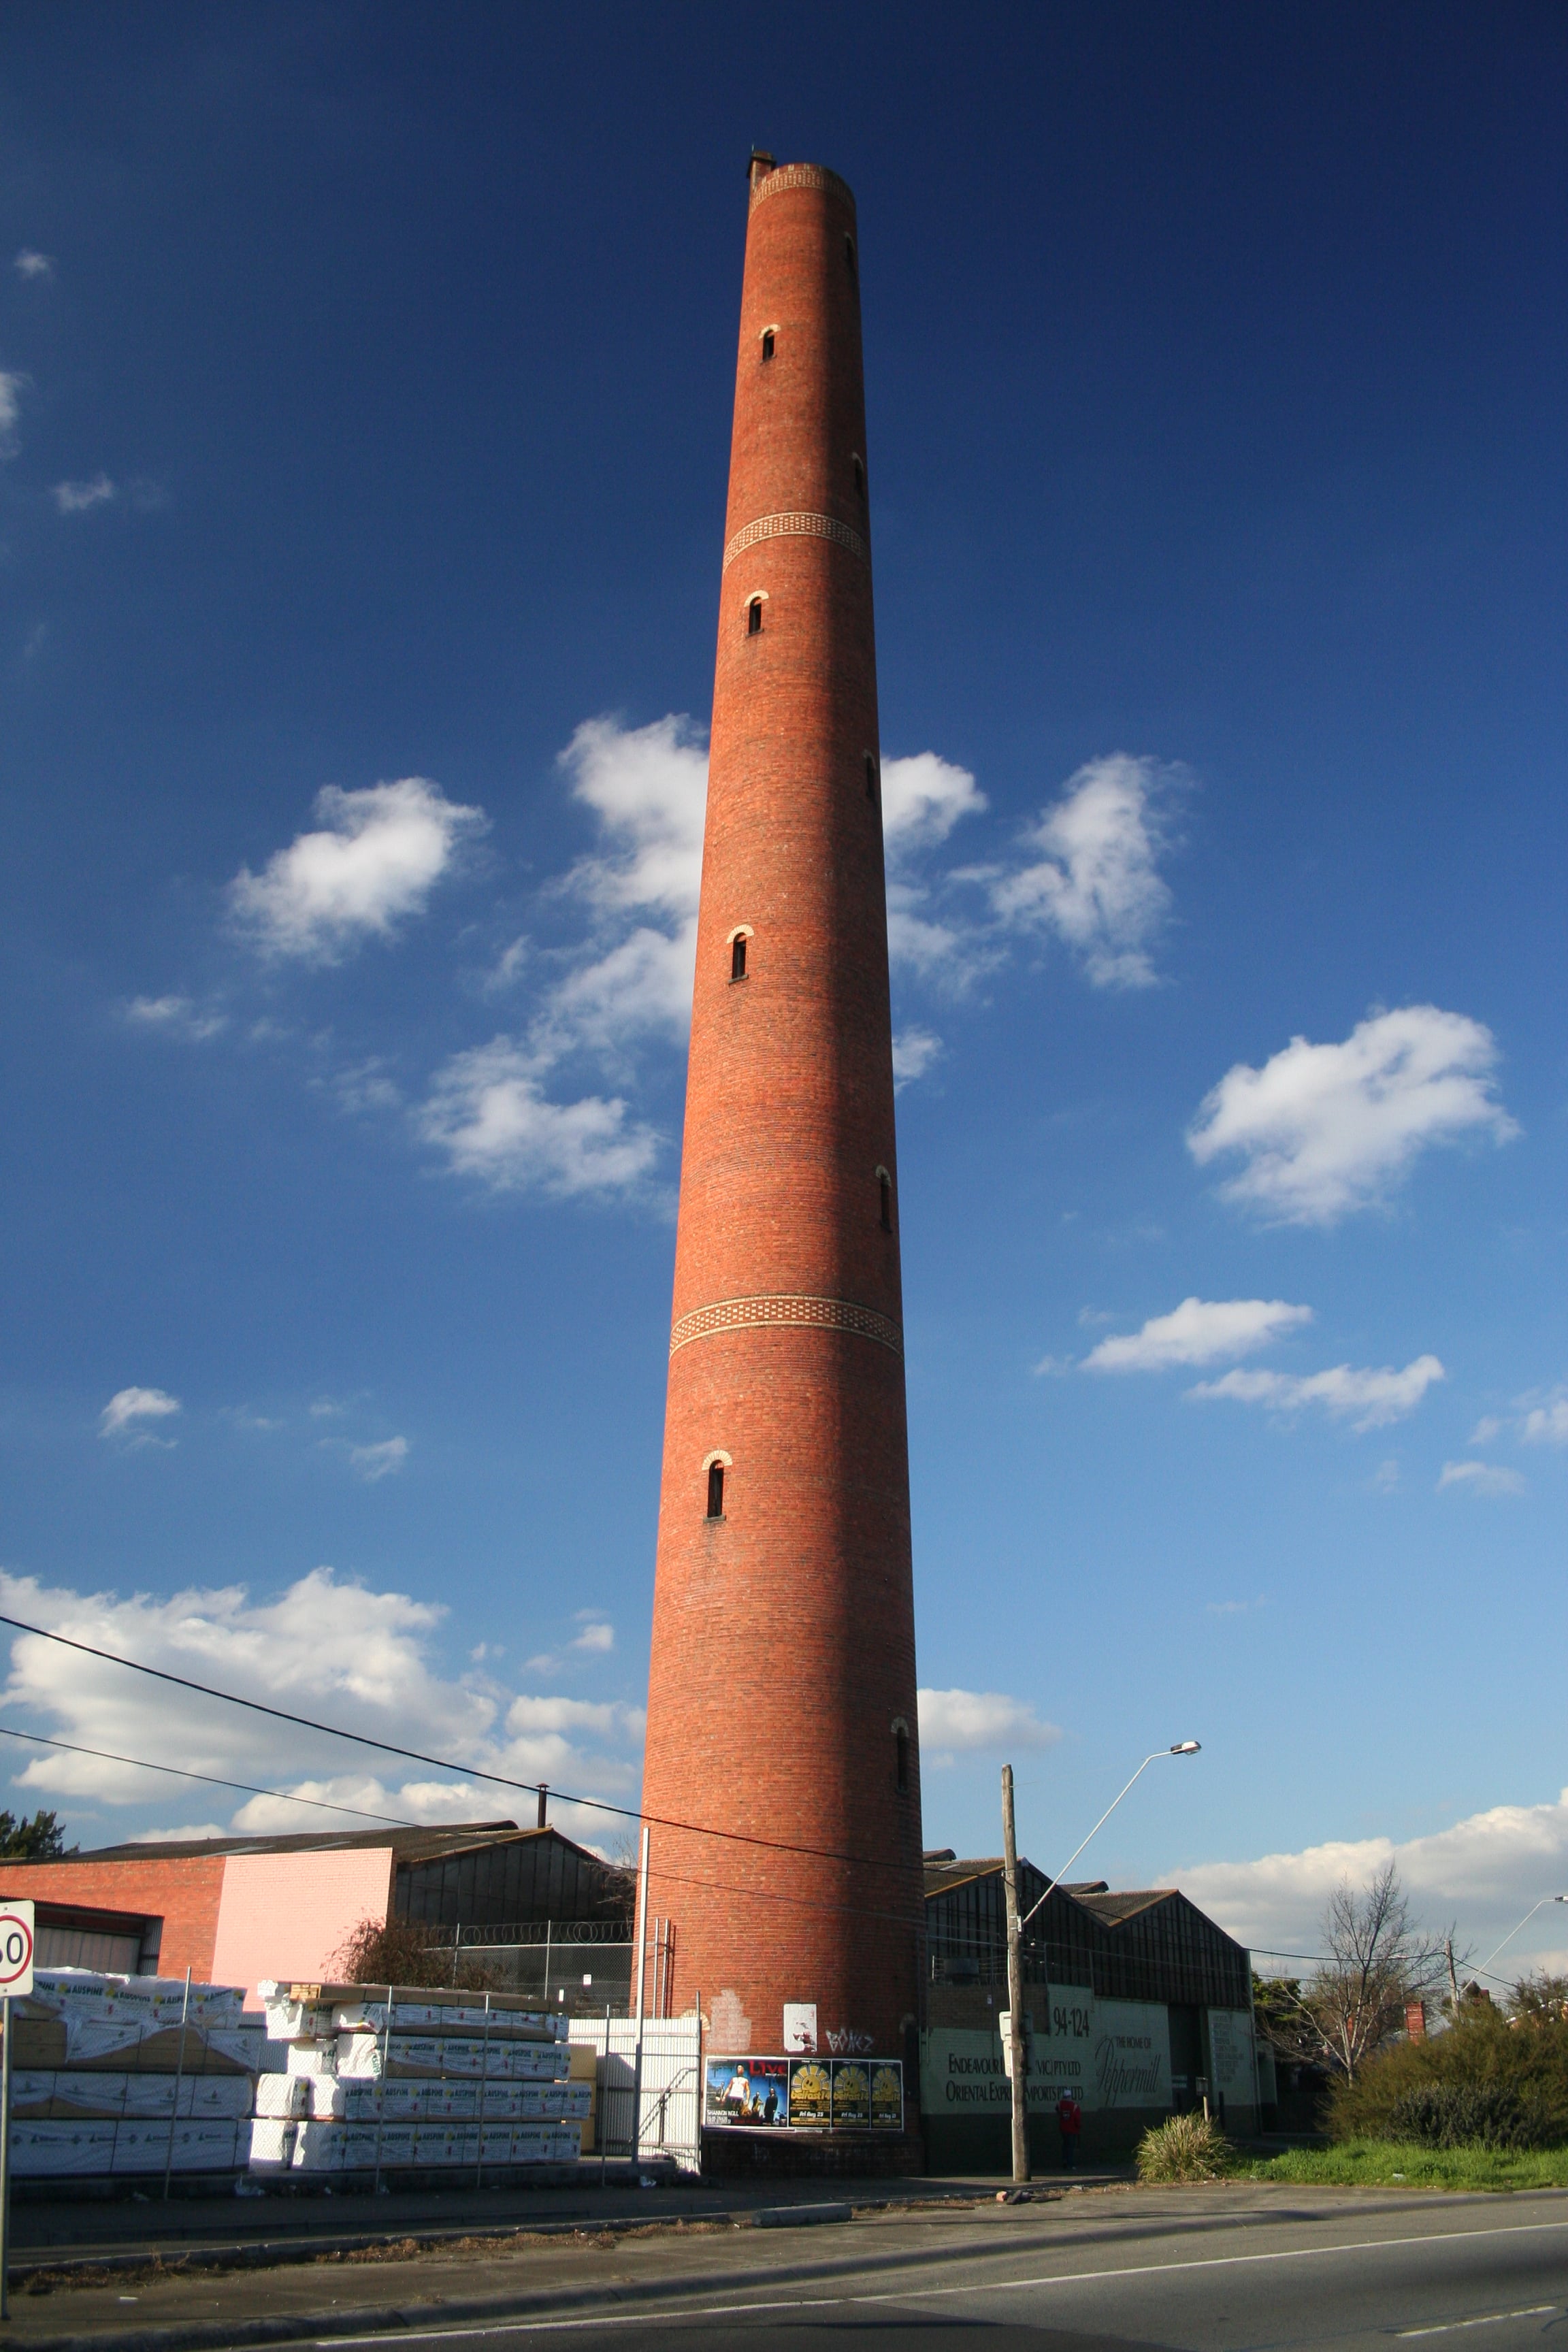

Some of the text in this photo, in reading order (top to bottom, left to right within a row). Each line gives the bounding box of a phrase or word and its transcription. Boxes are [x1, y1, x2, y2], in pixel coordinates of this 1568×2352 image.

[0, 1932, 24, 1964] 0
[72, 1984, 103, 1995] AUSPINE
[1054, 2008, 1090, 2037] 94-124
[1116, 2036, 1152, 2048] THE HOME OF
[949, 2053, 1000, 2074] ENDEAVOUR
[1054, 2060, 1067, 2076] PTY
[1068, 2061, 1081, 2076] LTD
[1096, 2036, 1161, 2107] Peppermill
[946, 2080, 987, 2102] ORIENTAL
[1023, 2085, 1056, 2102] MPORTS
